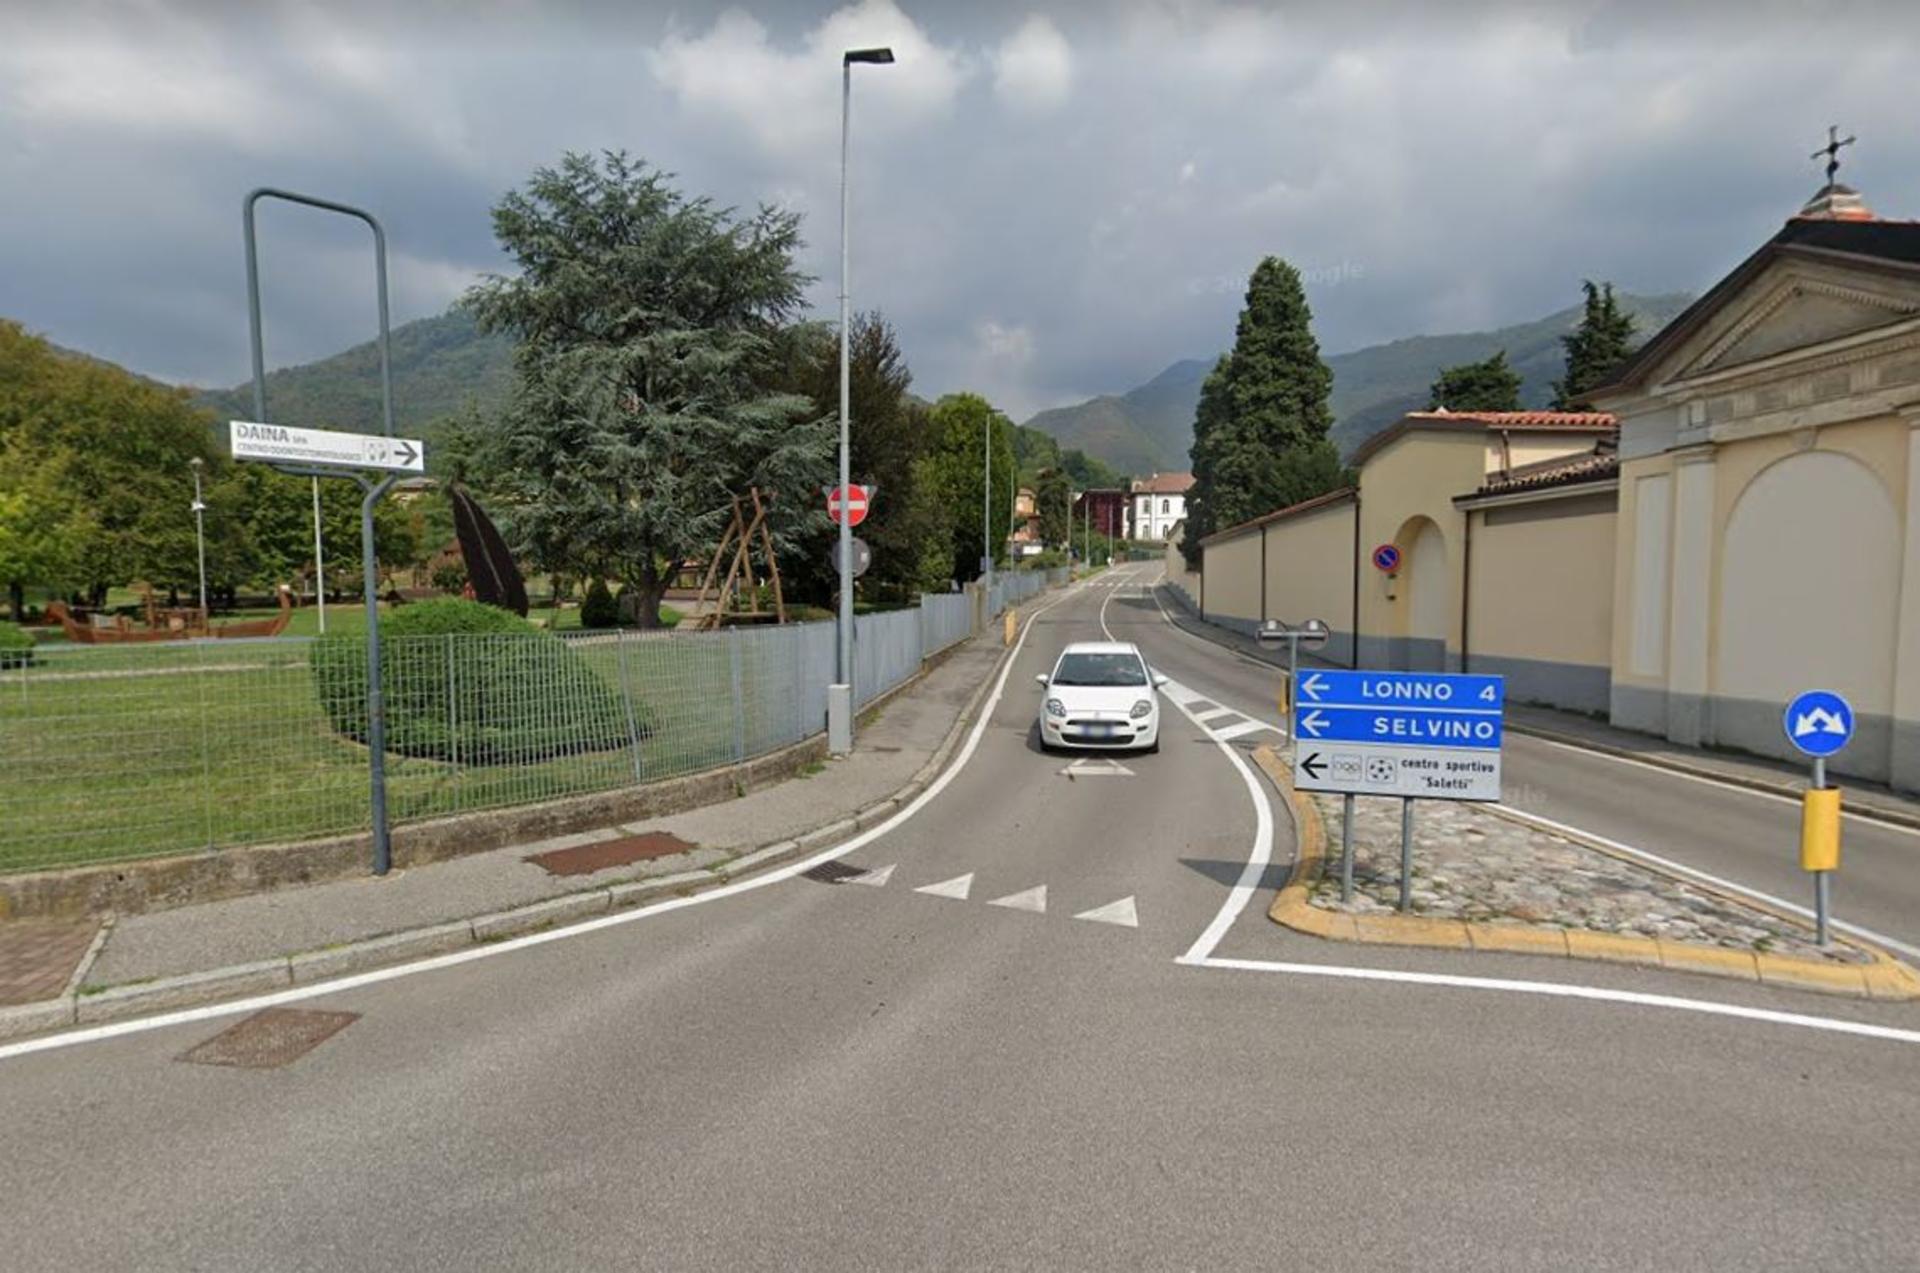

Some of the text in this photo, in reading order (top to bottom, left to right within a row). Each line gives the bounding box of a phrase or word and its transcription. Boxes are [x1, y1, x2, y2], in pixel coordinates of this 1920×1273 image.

[237, 425, 289, 442] DAINA
[1362, 680, 1496, 701] LONNO 4
[1374, 717, 1494, 739] SELVINO
[1401, 759, 1495, 773] centro sportivo
